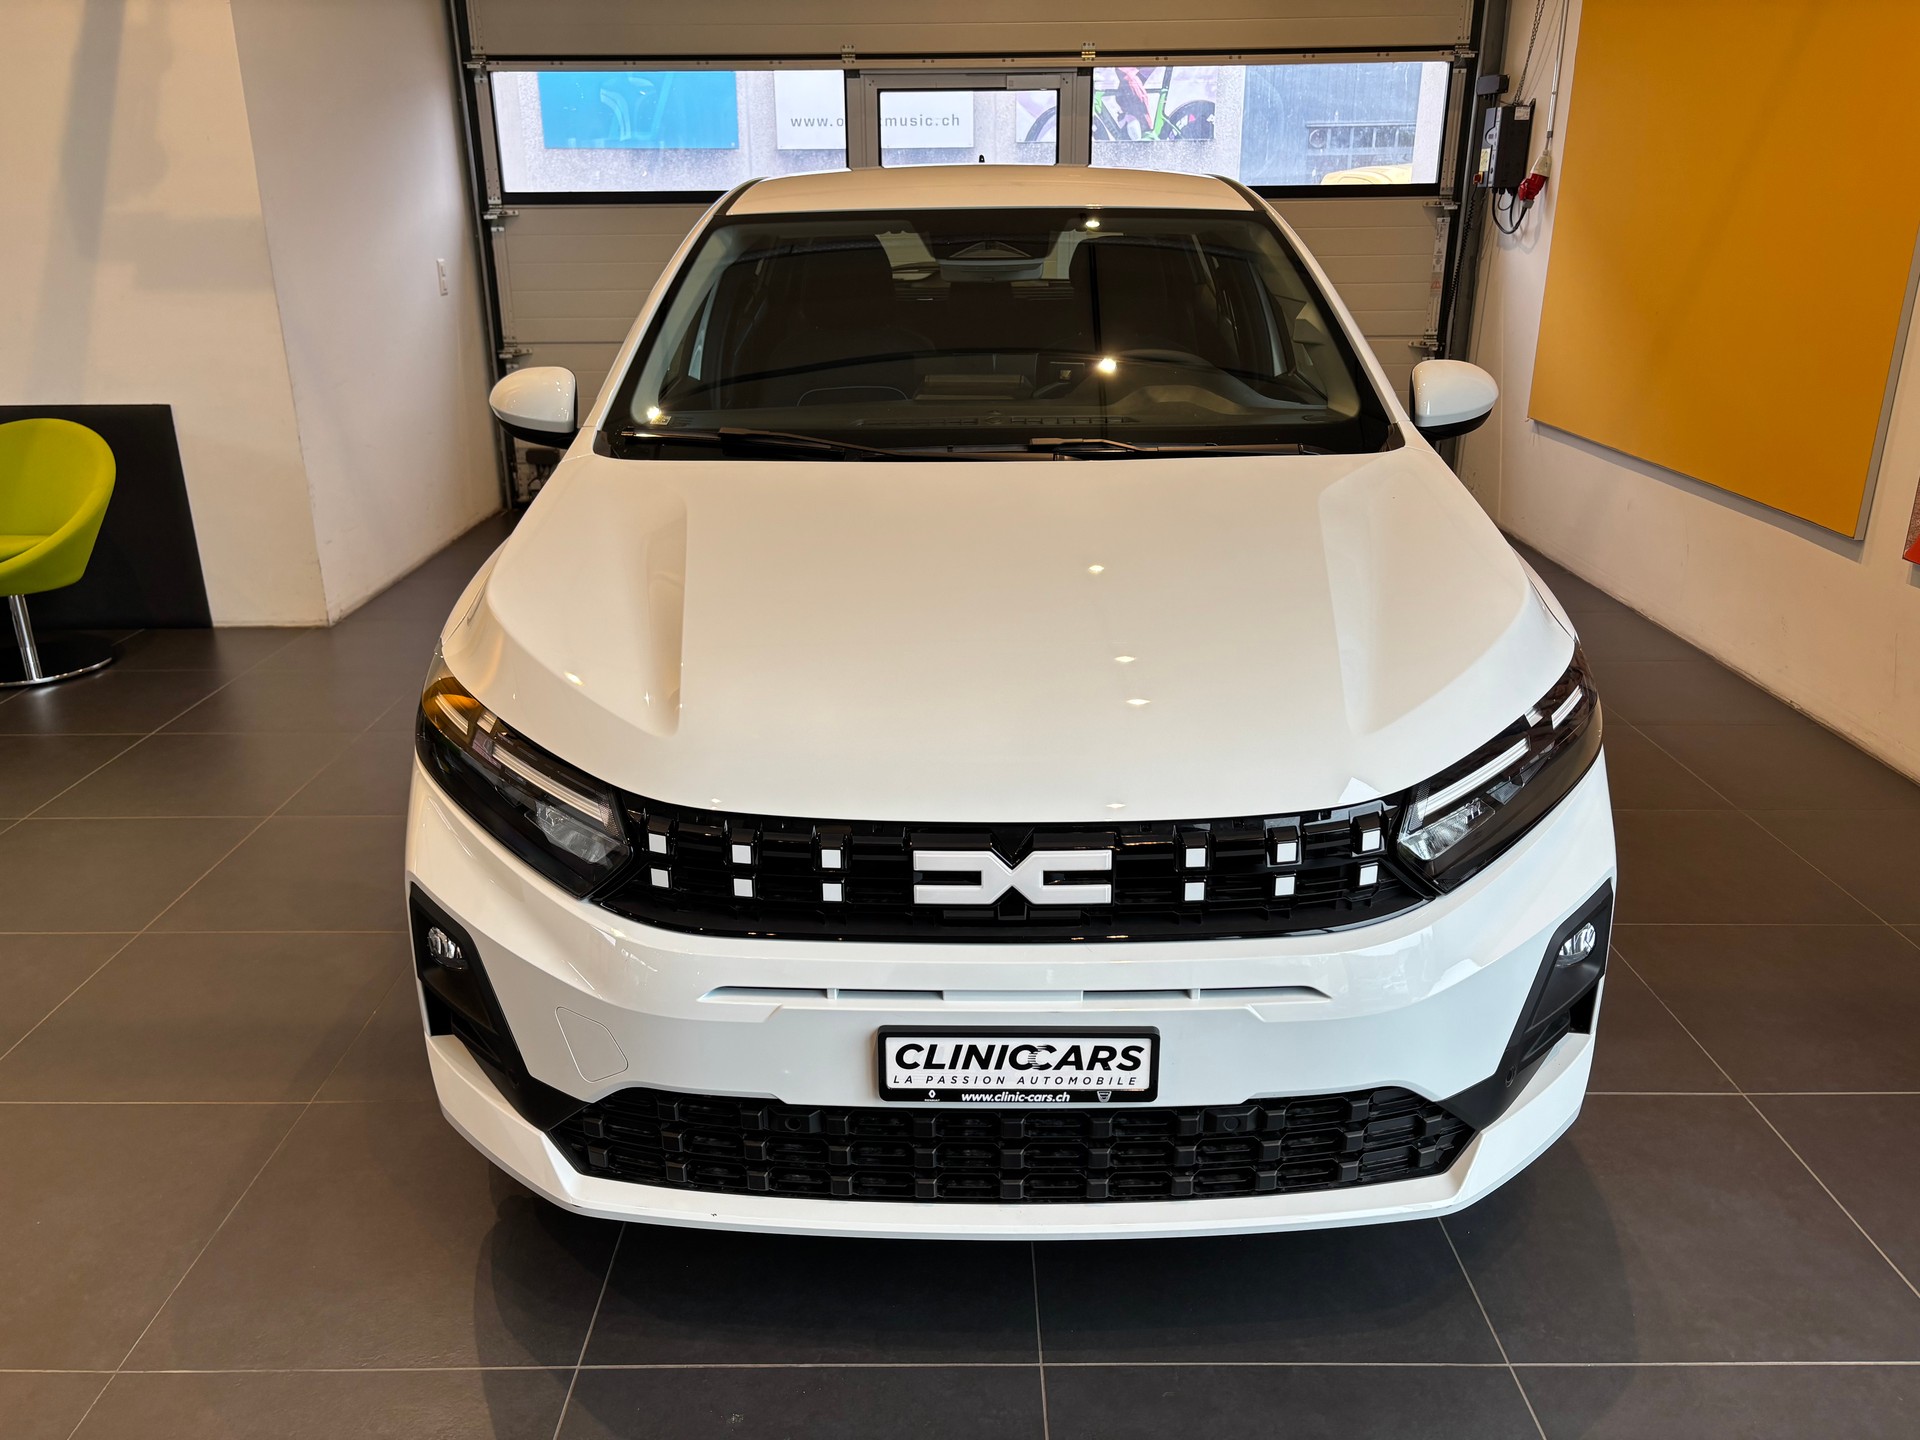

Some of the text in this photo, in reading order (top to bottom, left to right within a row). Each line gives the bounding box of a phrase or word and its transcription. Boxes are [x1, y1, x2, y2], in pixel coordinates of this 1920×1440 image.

[893, 1075, 1137, 1085] LA PASSION AUTOMOBILE
[961, 1091, 1071, 1102] www.clinic-cars.ch
